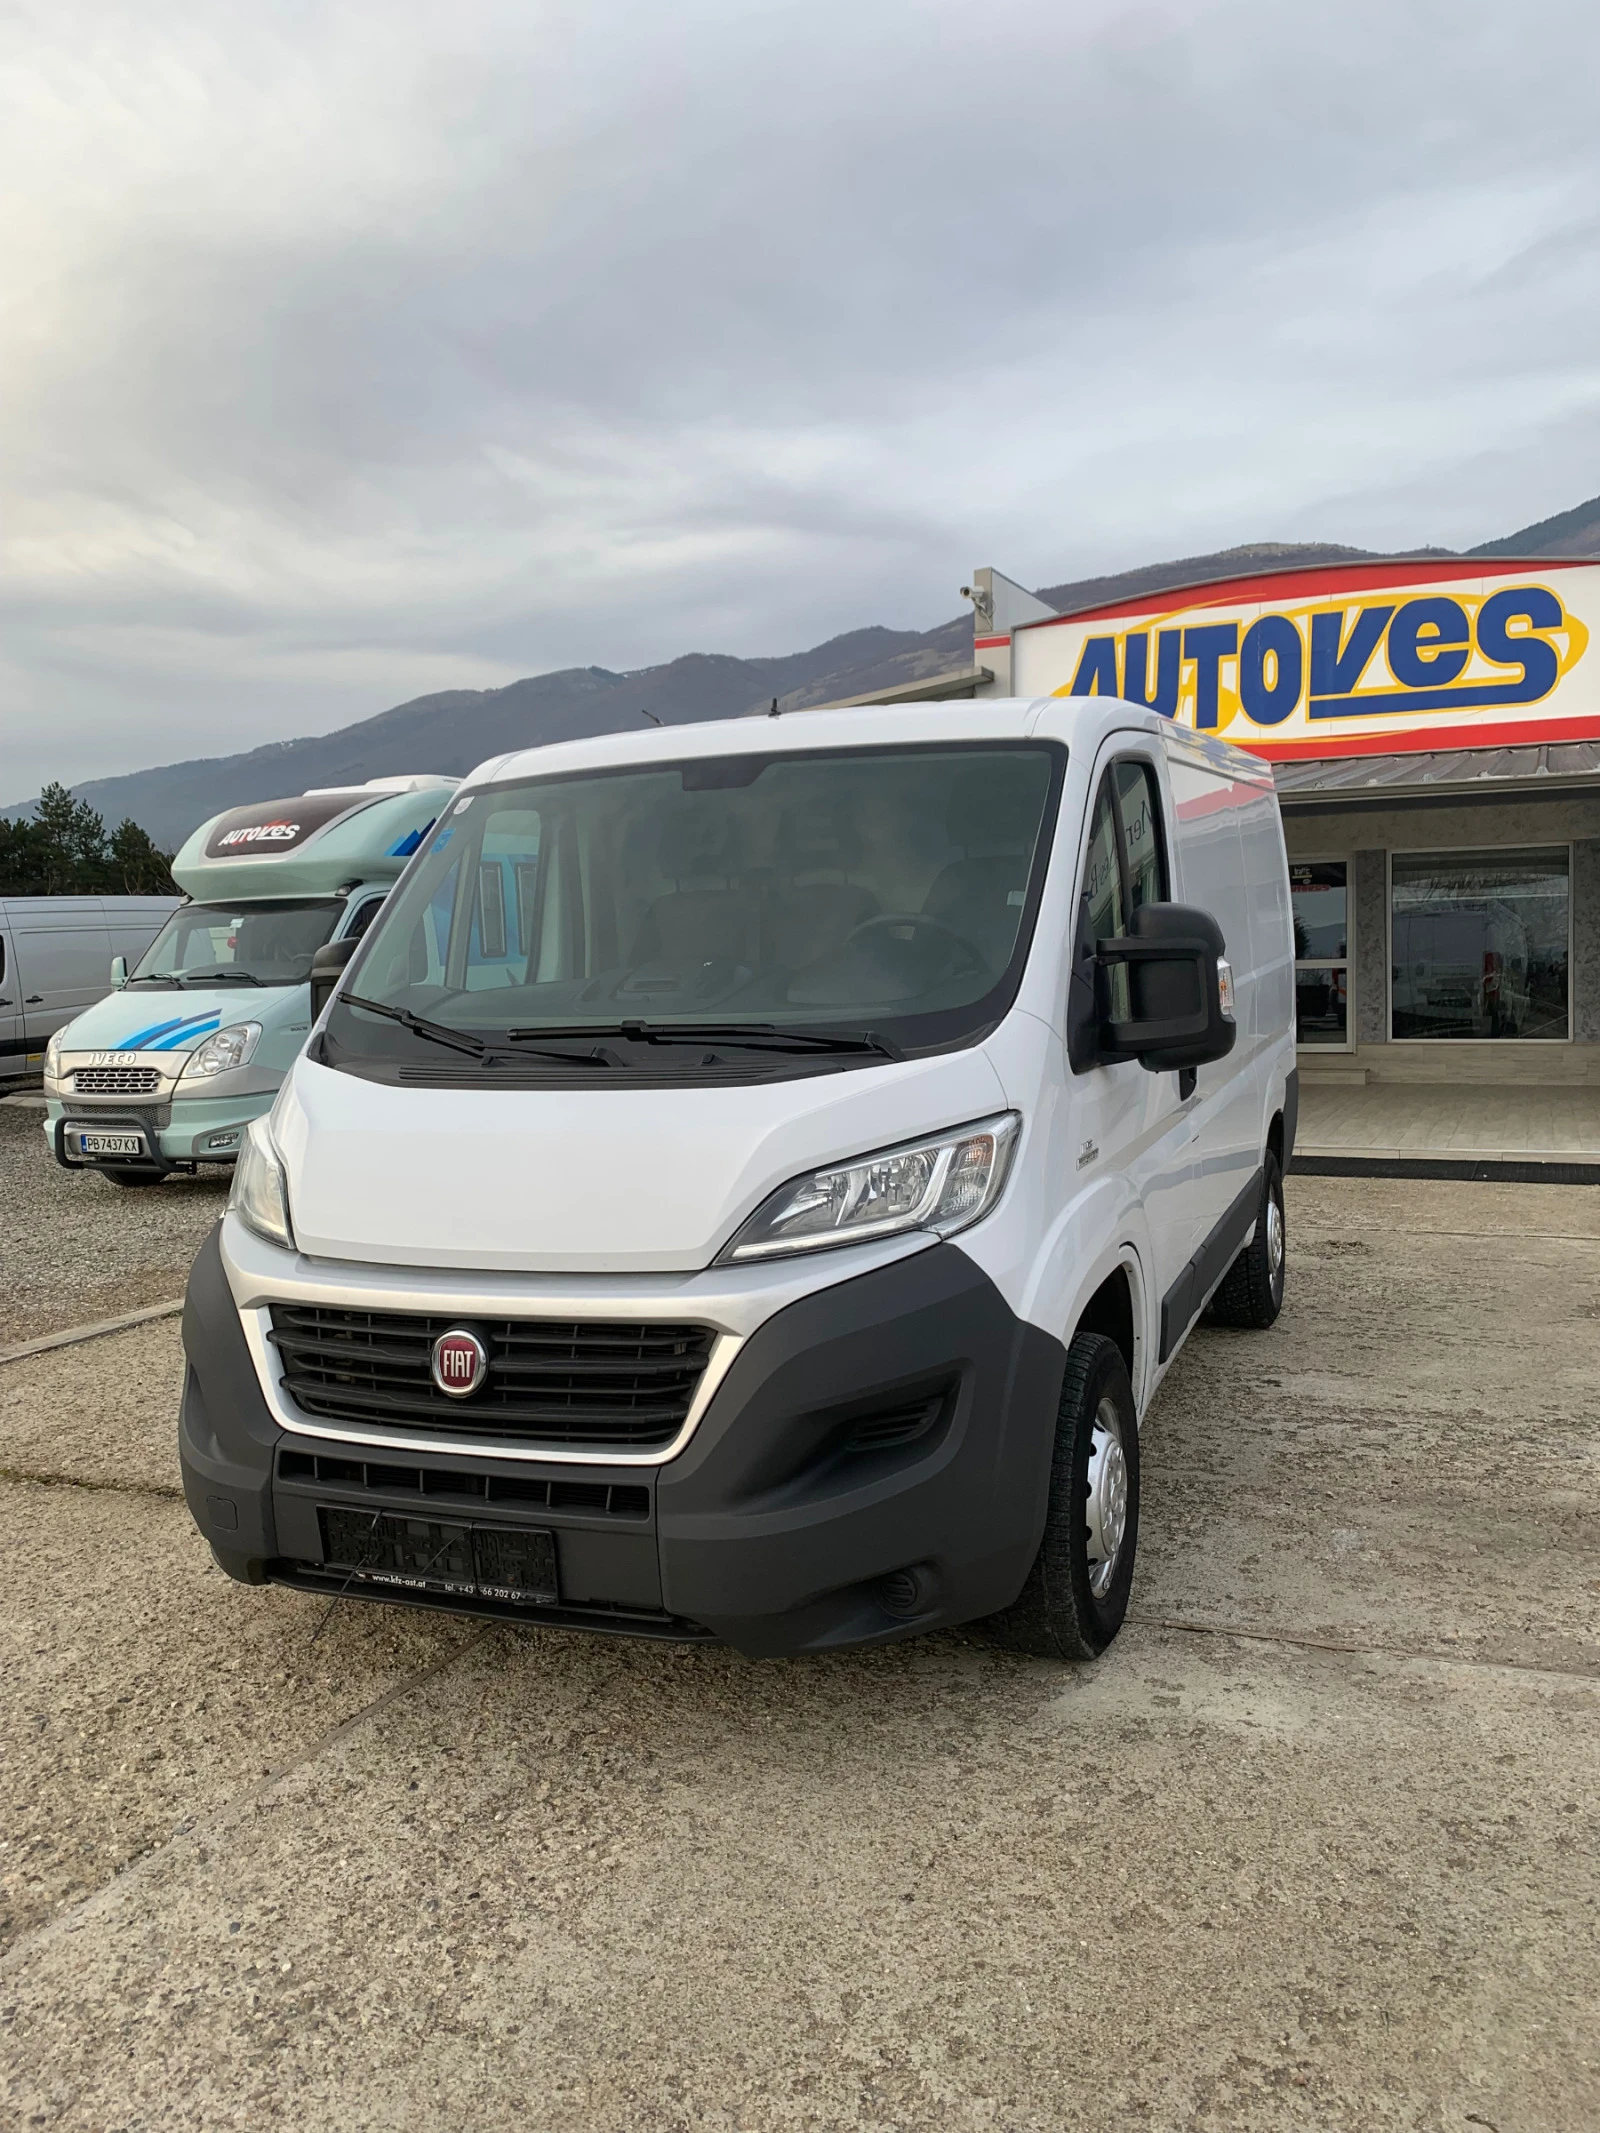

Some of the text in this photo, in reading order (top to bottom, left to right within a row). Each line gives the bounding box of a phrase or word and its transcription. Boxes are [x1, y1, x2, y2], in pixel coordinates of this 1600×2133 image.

[88, 1052, 136, 1066] IVECO
[443, 1349, 474, 1378] FIAT
[494, 1588, 509, 1599] 202
[510, 1591, 521, 1600] 67
